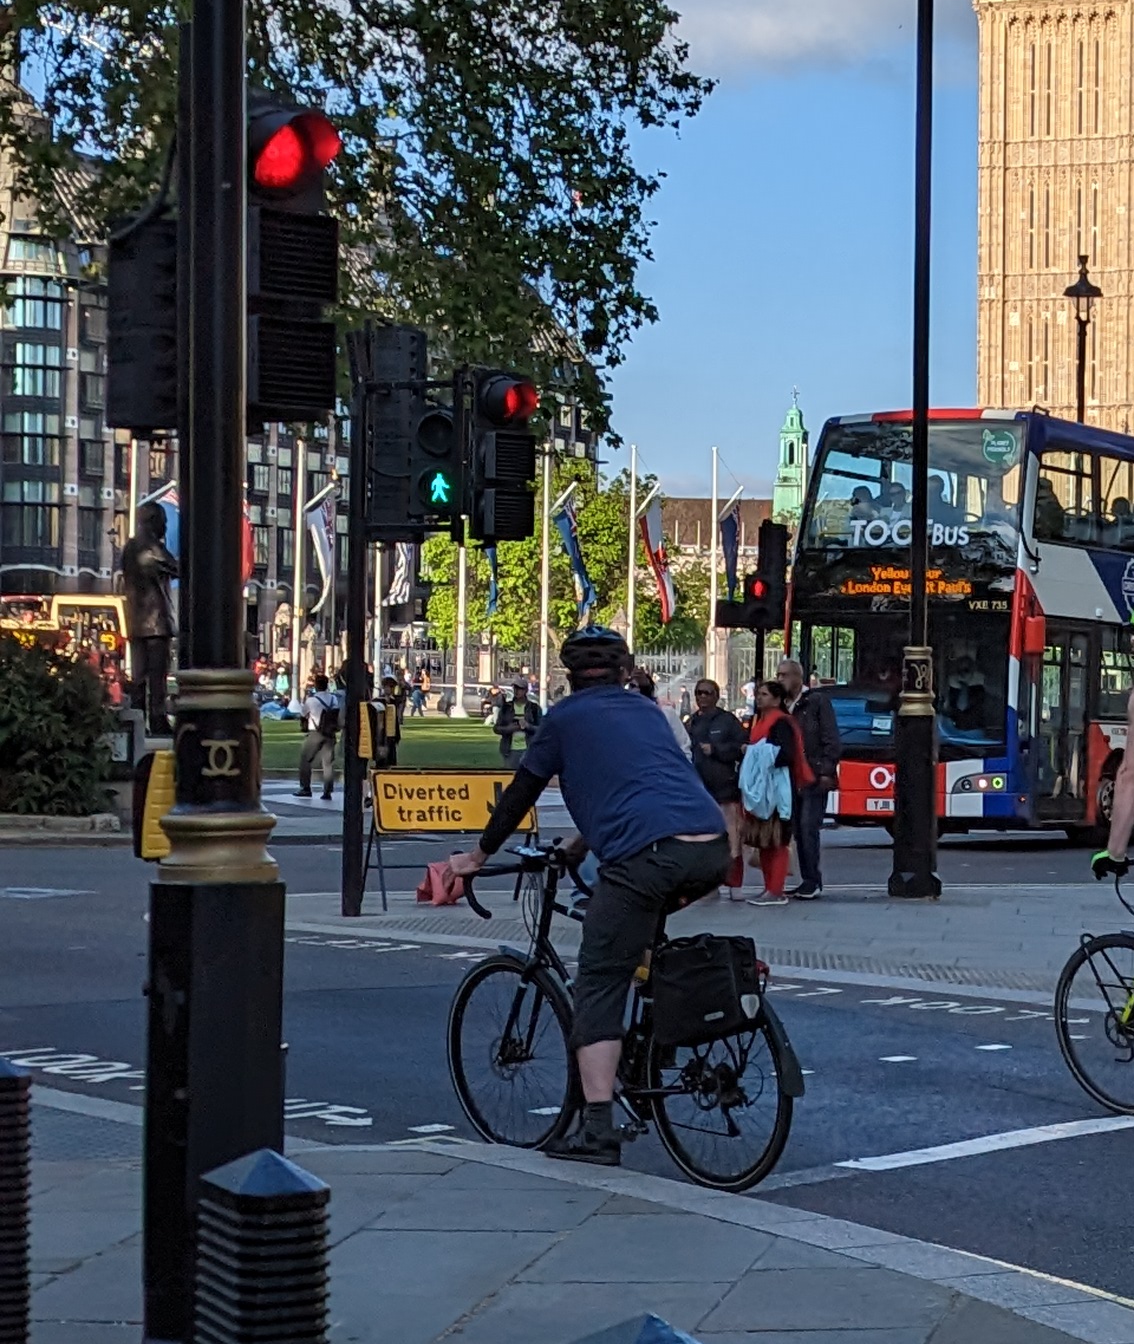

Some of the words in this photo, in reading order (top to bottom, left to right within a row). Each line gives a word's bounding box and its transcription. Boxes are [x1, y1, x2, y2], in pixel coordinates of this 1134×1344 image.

[850, 519, 970, 547] TOOBUS
[383, 783, 470, 800] Diverted
[397, 806, 463, 822] traffic
